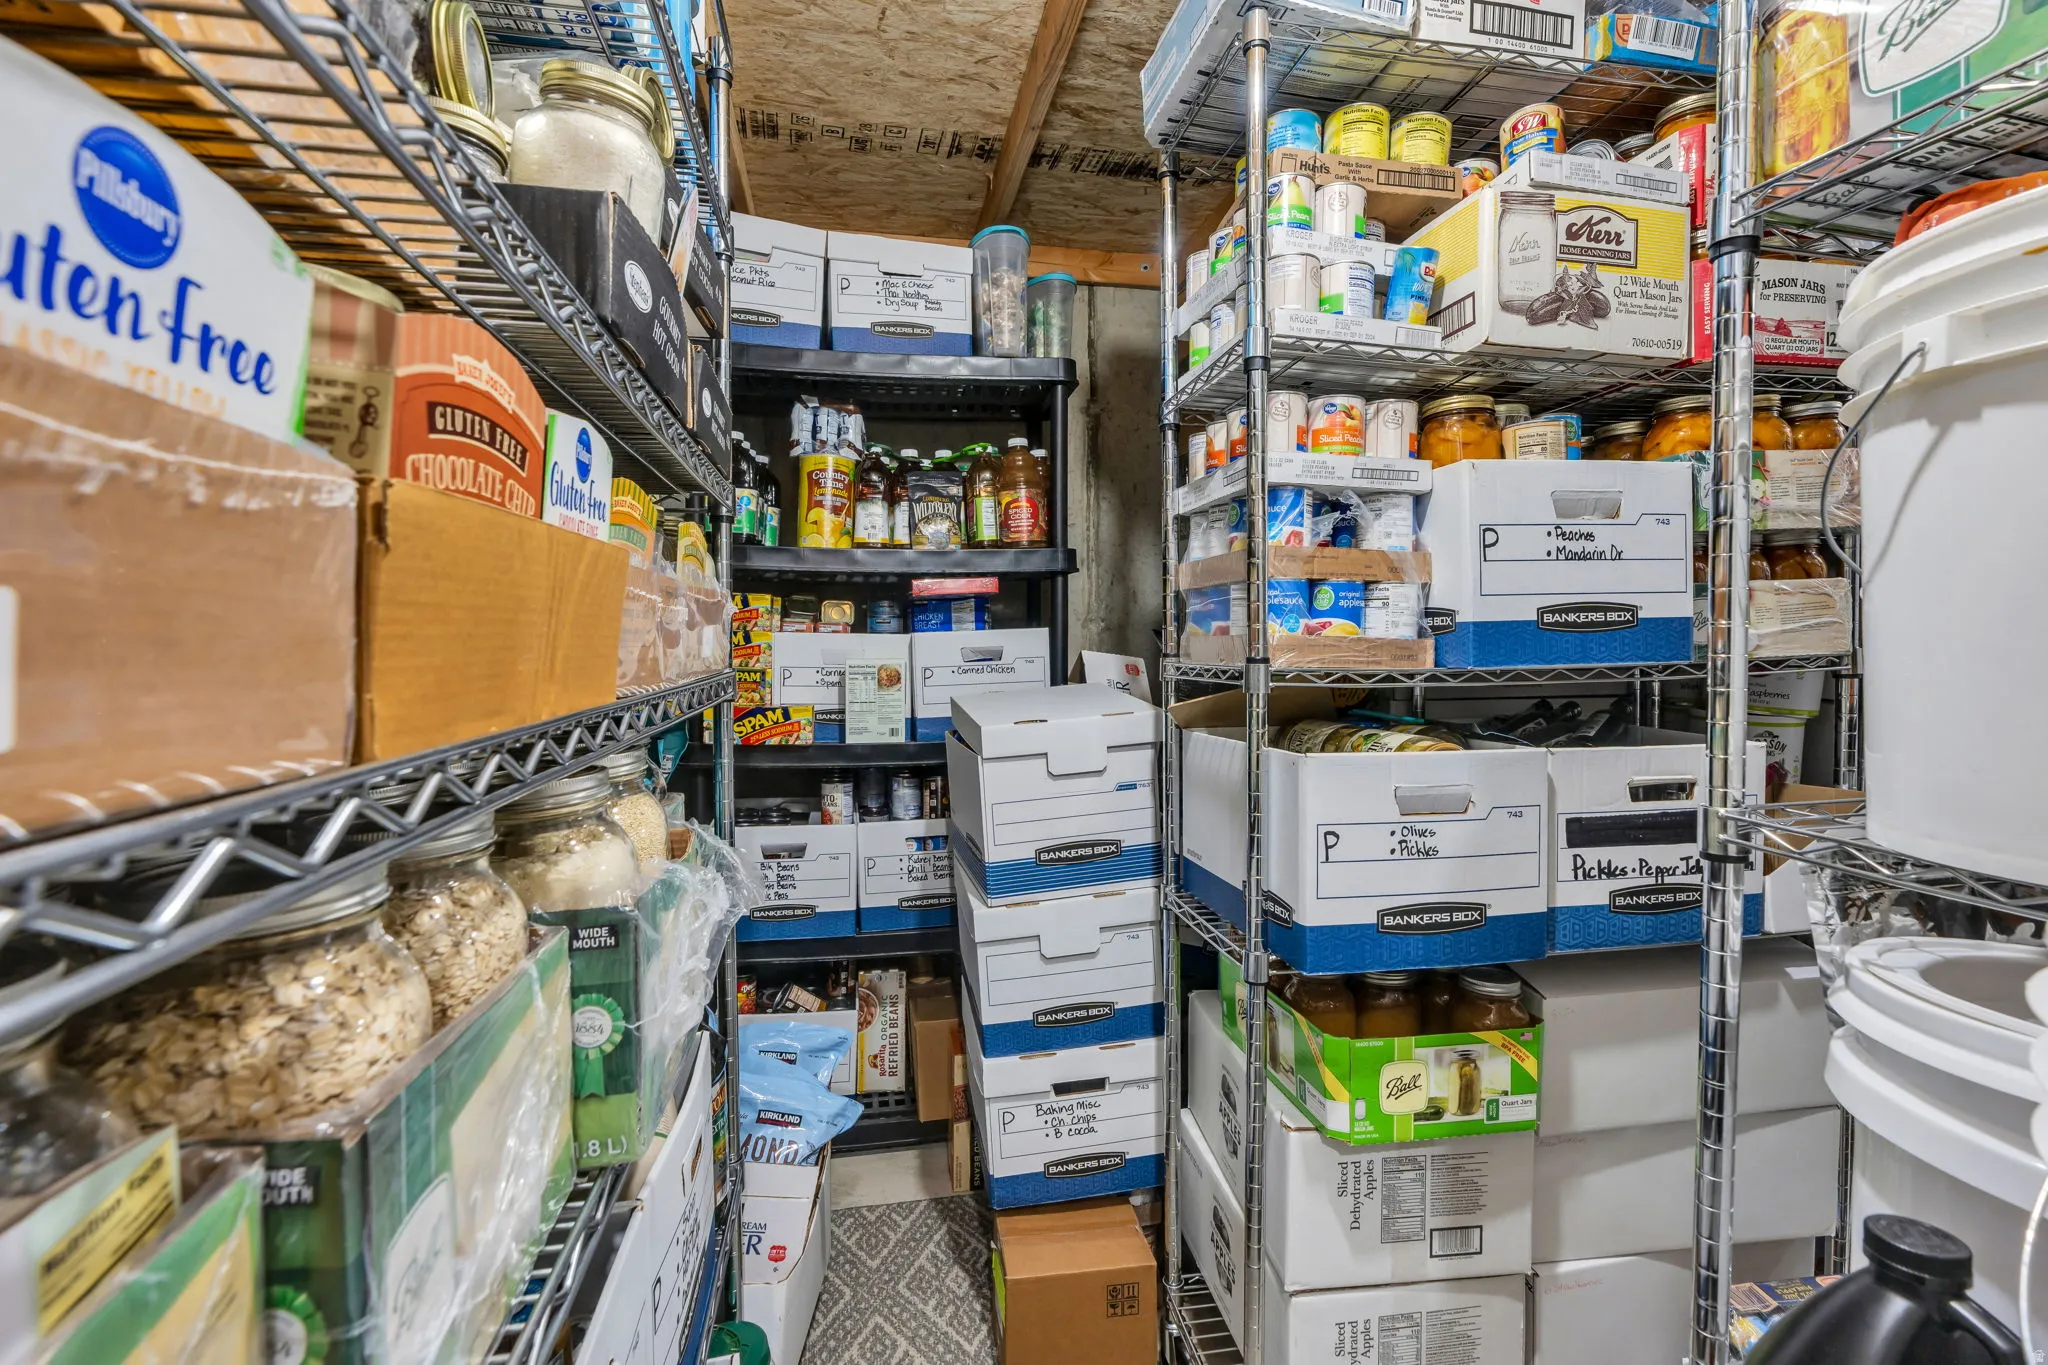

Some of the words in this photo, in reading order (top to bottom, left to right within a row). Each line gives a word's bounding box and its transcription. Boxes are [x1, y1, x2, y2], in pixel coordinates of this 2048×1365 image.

[1344, 108, 1370, 116] Nutrition
[1371, 108, 1384, 118] Facts
[1408, 116, 1433, 124] Nutrition
[1434, 118, 1447, 126] Facts
[1300, 160, 1331, 174] Hunt's
[1334, 174, 1351, 182] Garlic
[76, 146, 181, 248] Pillsbury
[1566, 215, 1624, 246] Kerr
[1561, 246, 1581, 254] HOME
[1582, 248, 1614, 258] CANNING
[1614, 250, 1630, 260] JARS
[1619, 276, 1628, 286] 12
[1631, 277, 1650, 288] Wide
[1653, 280, 1679, 292] Mouth
[1762, 278, 1798, 290] MASON
[1800, 279, 1826, 294] JARS
[1614, 287, 1638, 299] Quart
[1640, 289, 1666, 300] Mason
[1668, 293, 1682, 304] Jars
[1760, 292, 1770, 300] for
[1774, 293, 1826, 304] PRESERVING
[659, 296, 682, 349] GOURMET
[731, 311, 758, 323] NKERS
[759, 315, 778, 326] BOX
[1638, 310, 1656, 318] Canning
[1664, 312, 1678, 320] Storage
[159, 276, 277, 395] free
[874, 325, 912, 334] BANKERS
[914, 326, 932, 336] BOX
[1632, 338, 1682, 350] 70610-00519
[1826, 332, 1836, 347] 12
[653, 319, 667, 352] HOT
[666, 345, 680, 379] COCOA
[435, 406, 490, 444] GLUTEN
[495, 427, 522, 465] FREE
[812, 470, 850, 484] Country
[819, 479, 844, 490] Time
[405, 453, 504, 502] CHOCOLATE
[506, 479, 536, 518] CHIP
[550, 461, 586, 514] Gluten
[587, 480, 606, 523] free
[814, 487, 848, 498] Lemonade
[1656, 518, 1670, 526] 743
[1482, 527, 1500, 561] P
[1554, 526, 1595, 542] Peaches
[1556, 545, 1607, 561] Mandarin
[1339, 591, 1360, 600] original
[914, 612, 944, 621] CHICKEN
[1434, 615, 1453, 626] BOX
[1544, 611, 1605, 624] BANKERS
[1606, 611, 1634, 623] BOX
[914, 621, 942, 630] BREAST
[736, 672, 761, 682] PAM
[783, 669, 792, 686] P
[820, 678, 842, 688] Spam
[924, 668, 934, 687] P
[957, 666, 984, 676] Canned
[986, 664, 1016, 674] Chicken
[1748, 689, 1790, 700] aspberries
[734, 707, 786, 738] SPAM
[1507, 810, 1524, 819] 743
[1324, 831, 1340, 862] P
[1401, 826, 1436, 838] Olives
[1400, 841, 1440, 858] Pickles
[1040, 847, 1092, 862] BANKERS
[1094, 844, 1118, 855] BOX
[867, 859, 876, 876] P
[908, 854, 932, 866] Kidney
[933, 854, 952, 862] Beans
[908, 865, 926, 874] Chili
[933, 864, 953, 872] Beans
[1572, 854, 1628, 882] Pickles
[1638, 858, 1679, 884] Pepper
[1680, 856, 1703, 877] Jel
[908, 873, 928, 882] Baked
[934, 872, 954, 880] Beans
[774, 892, 789, 900] Peas
[902, 898, 940, 907] BANKERS
[940, 896, 957, 904] BOX
[1616, 893, 1674, 906] BANKERS
[1676, 890, 1701, 902] BOX
[754, 908, 794, 917] BANKERS
[794, 908, 812, 916] BOX
[1274, 906, 1290, 921] BOX
[1384, 913, 1451, 926] BANKERS
[1453, 911, 1481, 922] BOX
[578, 926, 609, 938] WIDE
[572, 936, 616, 950] MOUTH
[888, 994, 899, 1034] BEANS
[1038, 1009, 1087, 1023] BANKERS
[1089, 1006, 1110, 1017] BOX
[888, 1035, 898, 1077] REFRIED
[1500, 1044, 1512, 1054] BPA
[1512, 1050, 1526, 1064] FREE
[1386, 1073, 1422, 1100] Ball
[1036, 1103, 1074, 1117] Baking
[1076, 1100, 1101, 1110] Misc
[1502, 1100, 1518, 1108] Quart
[760, 1110, 800, 1124] KIRKLAND
[1003, 1111, 1016, 1132] P
[1219, 1101, 1242, 1147] APPLES
[1055, 1128, 1062, 1139] B
[1068, 1126, 1098, 1137] cocoa
[974, 1154, 982, 1186] BEANS
[1049, 1160, 1098, 1173] BANKERS
[1100, 1156, 1122, 1166] BOX
[1338, 1160, 1348, 1198] Sliced
[1364, 1159, 1378, 1200] Apples
[1350, 1160, 1364, 1231] Dehydrated
[1210, 1229, 1236, 1286] APPLES
[1335, 1322, 1346, 1357] Sliced
[1362, 1318, 1376, 1359] Apples
